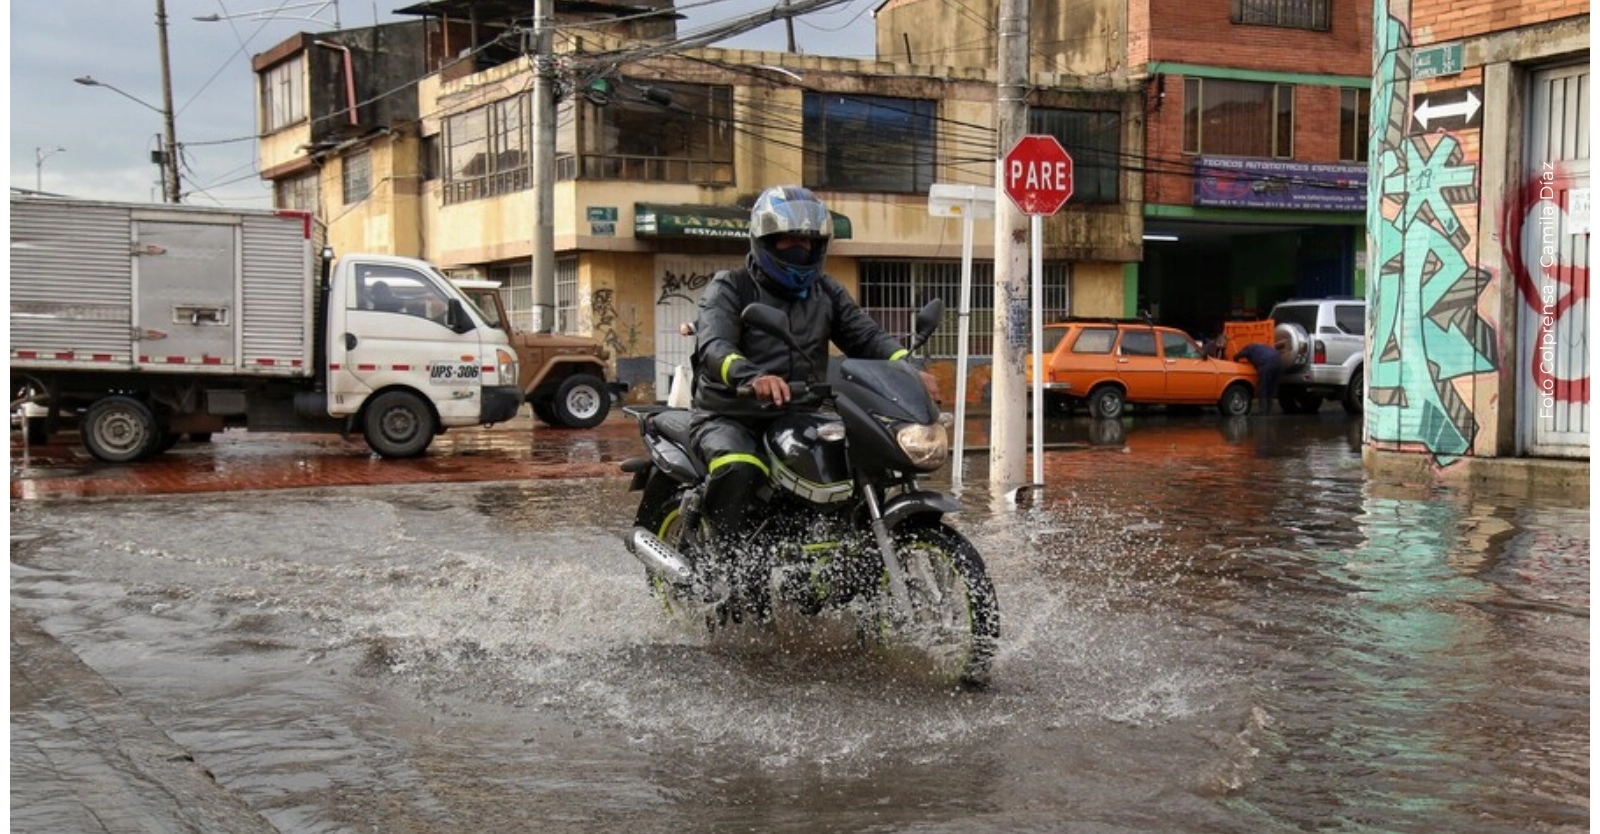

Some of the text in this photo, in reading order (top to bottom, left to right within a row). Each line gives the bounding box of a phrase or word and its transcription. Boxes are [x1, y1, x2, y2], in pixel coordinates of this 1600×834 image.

[1203, 159, 1369, 173] TECNICOS AUTOMOTRICES ESPECIALIZADO
[1011, 161, 1066, 190] PARE
[673, 215, 702, 226] LA
[684, 228, 750, 238] RESTAURAN
[431, 365, 479, 378] UPS-306
